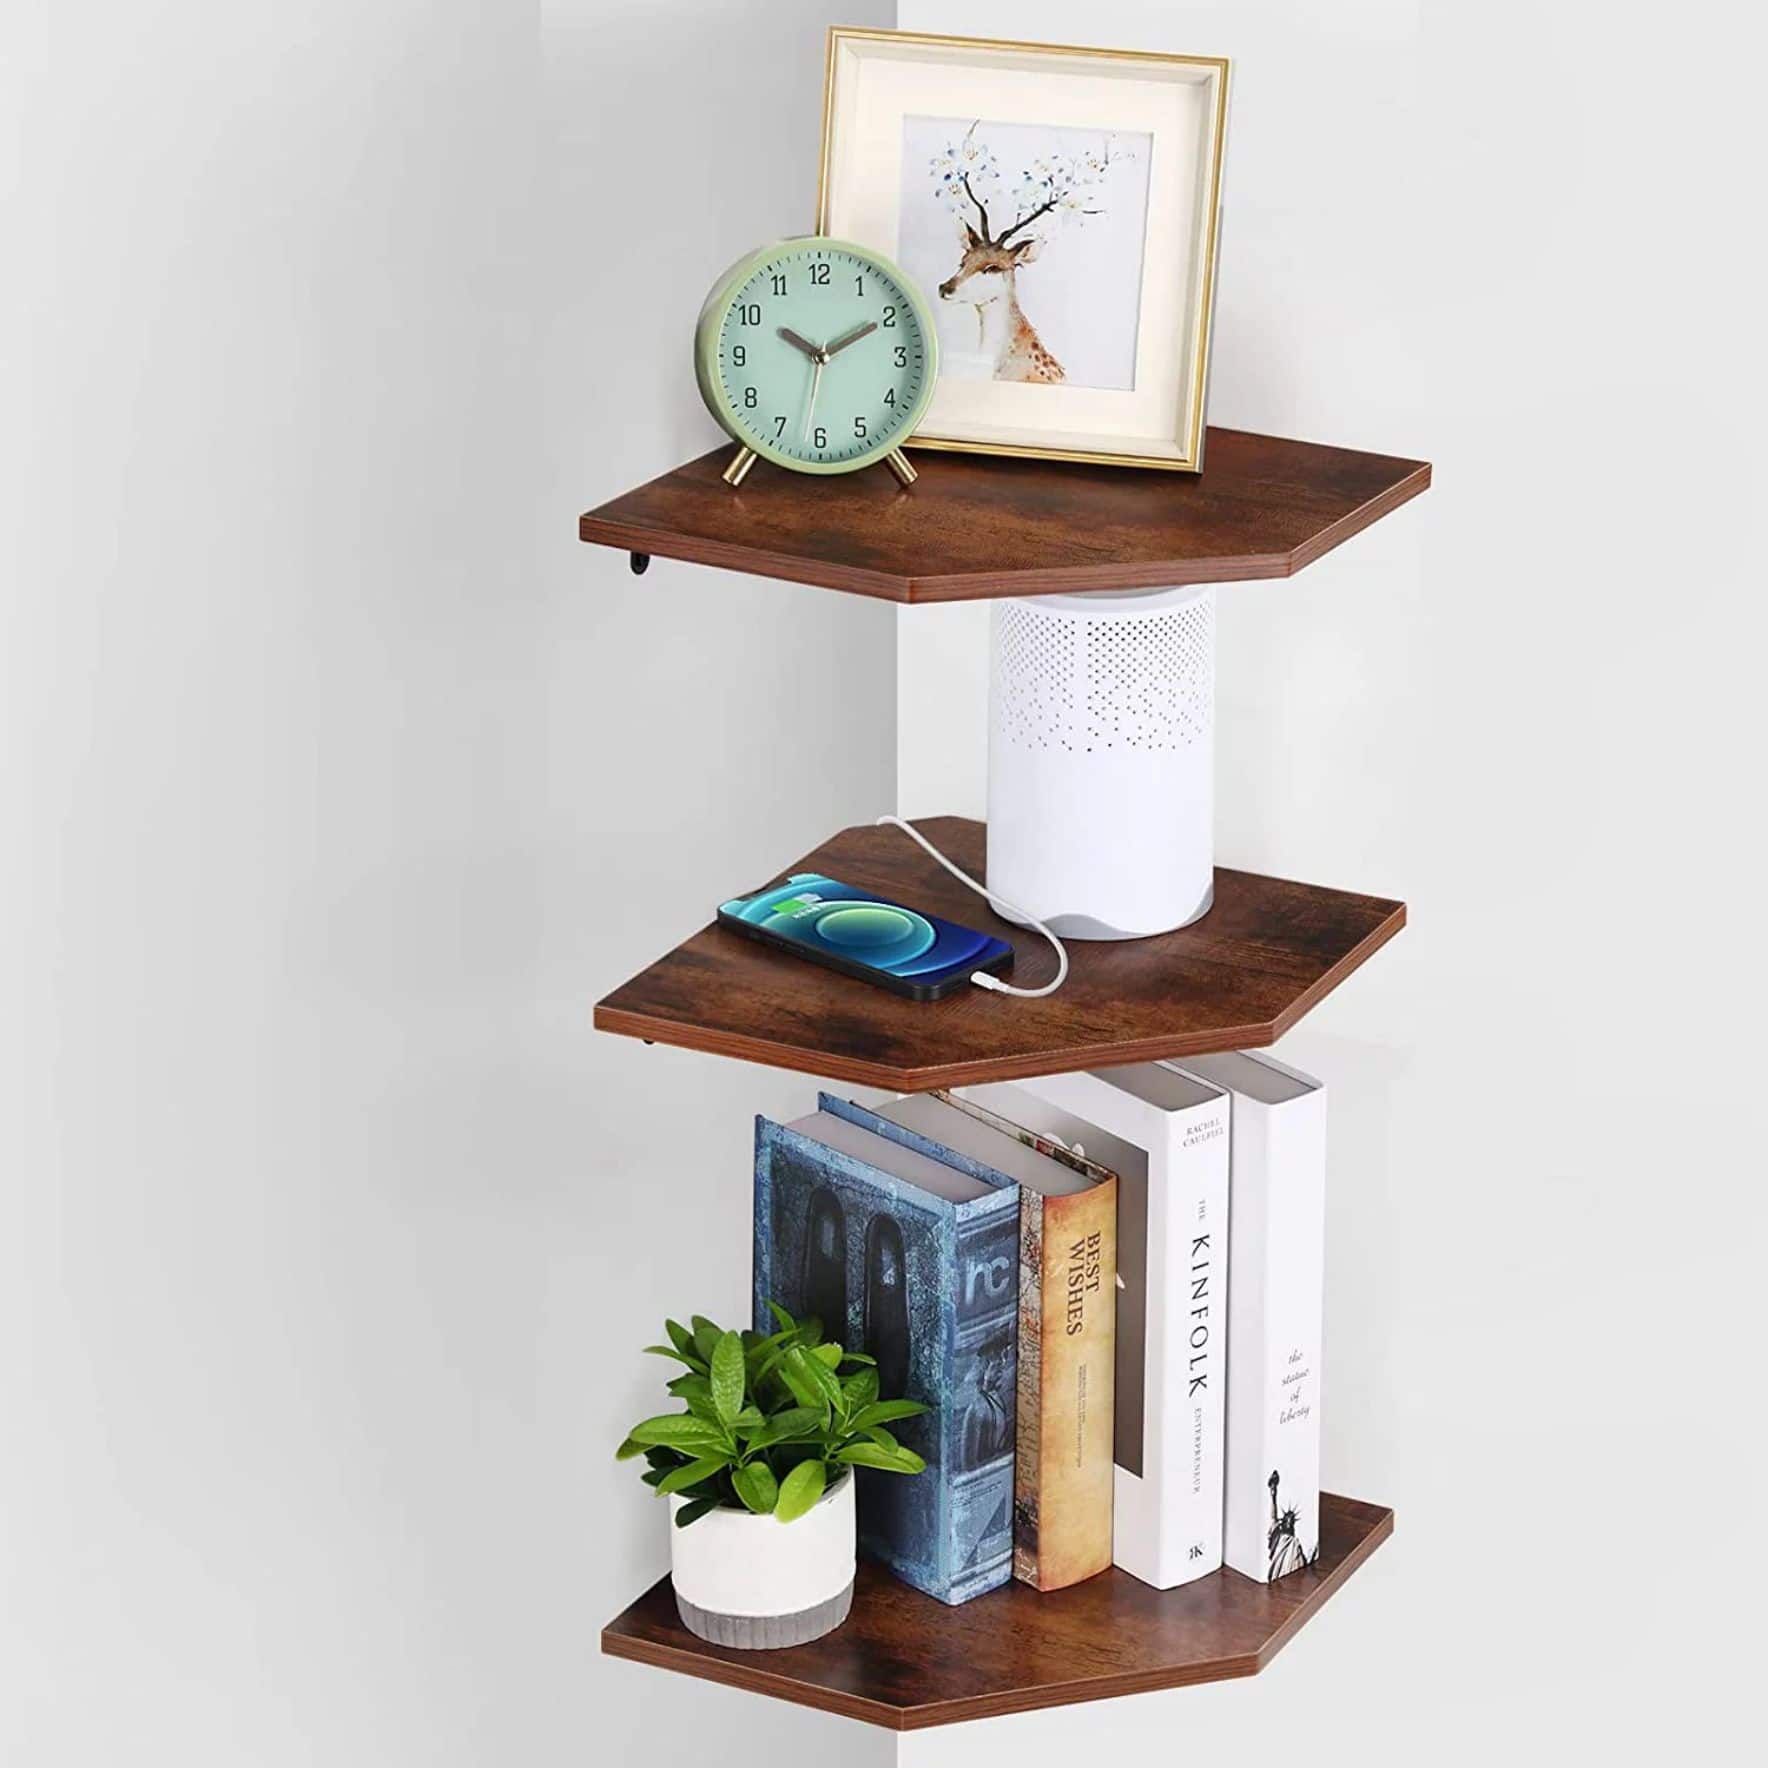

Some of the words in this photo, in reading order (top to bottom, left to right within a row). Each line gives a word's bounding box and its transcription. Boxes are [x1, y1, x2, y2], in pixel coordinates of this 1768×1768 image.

[808, 263, 831, 285] 12
[770, 275, 788, 296] 11
[855, 276, 864, 297] 1
[738, 304, 761, 326] 10
[883, 306, 896, 328] 2
[733, 345, 746, 367] 9
[894, 346, 907, 368] 3
[744, 387, 757, 408] 8
[884, 388, 896, 409] 4
[774, 417, 787, 438] 7
[855, 417, 867, 438] 5
[814, 428, 827, 449] 6
[1197, 1199, 1207, 1221] THE
[1085, 1230, 1102, 1293] BEST
[1066, 1239, 1086, 1336] WISHES
[1188, 1233, 1210, 1398] KINFOLK
[1287, 1348, 1304, 1365] the
[1289, 1385, 1301, 1404] of
[1279, 1406, 1310, 1425] liberty
